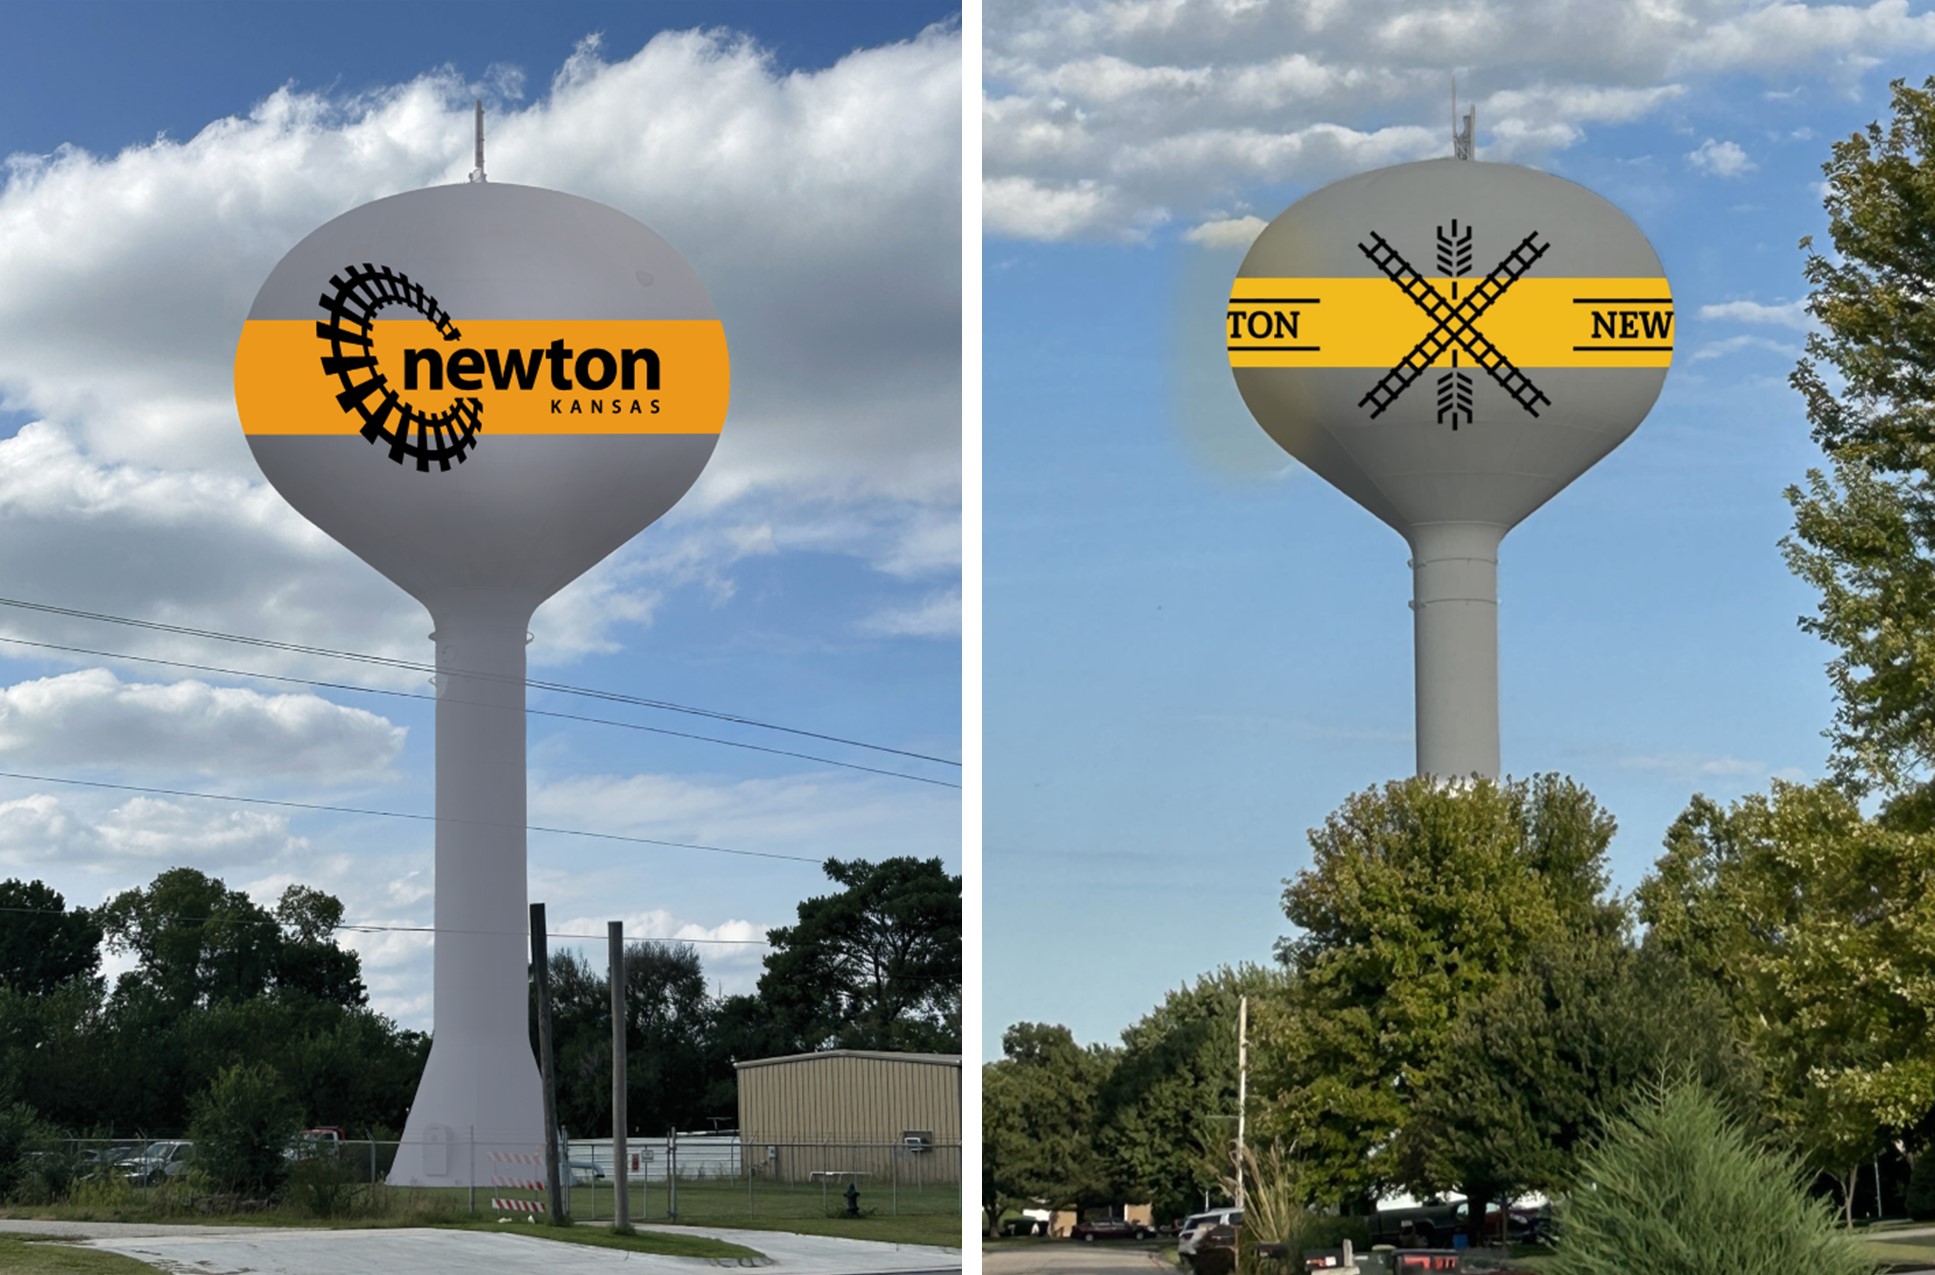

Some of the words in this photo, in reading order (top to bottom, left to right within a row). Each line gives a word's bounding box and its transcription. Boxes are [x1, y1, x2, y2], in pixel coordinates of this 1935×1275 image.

[1226, 310, 1300, 339] TON
[1591, 310, 1674, 339] NEW
[403, 338, 661, 391] newton
[550, 399, 661, 414] KANSAS
